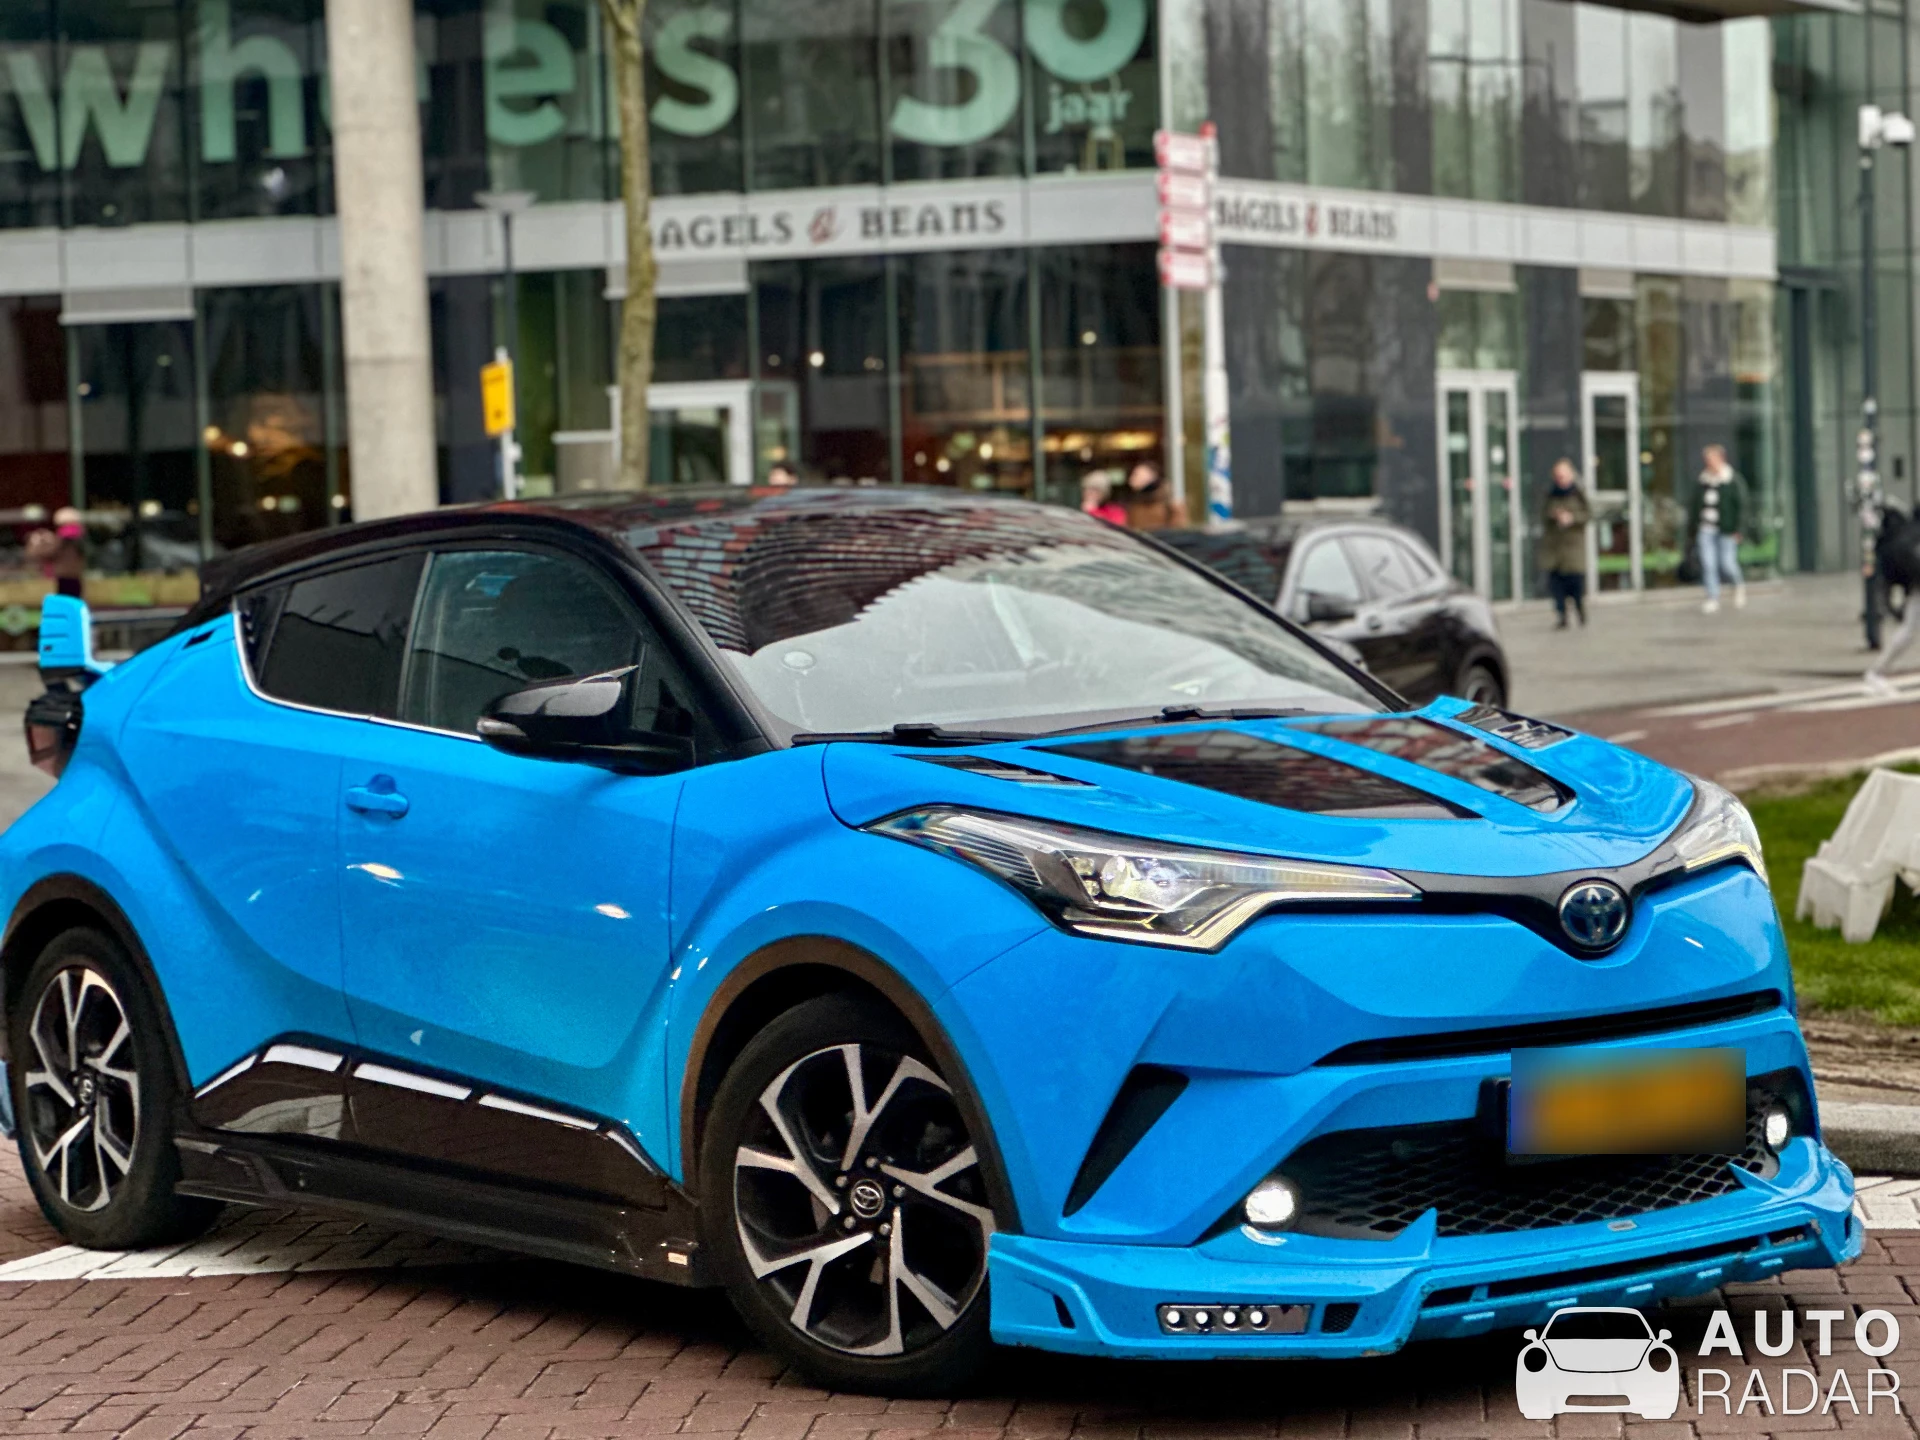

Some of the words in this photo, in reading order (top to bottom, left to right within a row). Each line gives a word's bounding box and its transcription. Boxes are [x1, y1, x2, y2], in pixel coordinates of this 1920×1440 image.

[1043, 82, 1132, 134] jaar
[654, 210, 793, 249] AGELS
[860, 199, 1006, 239] BEANS
